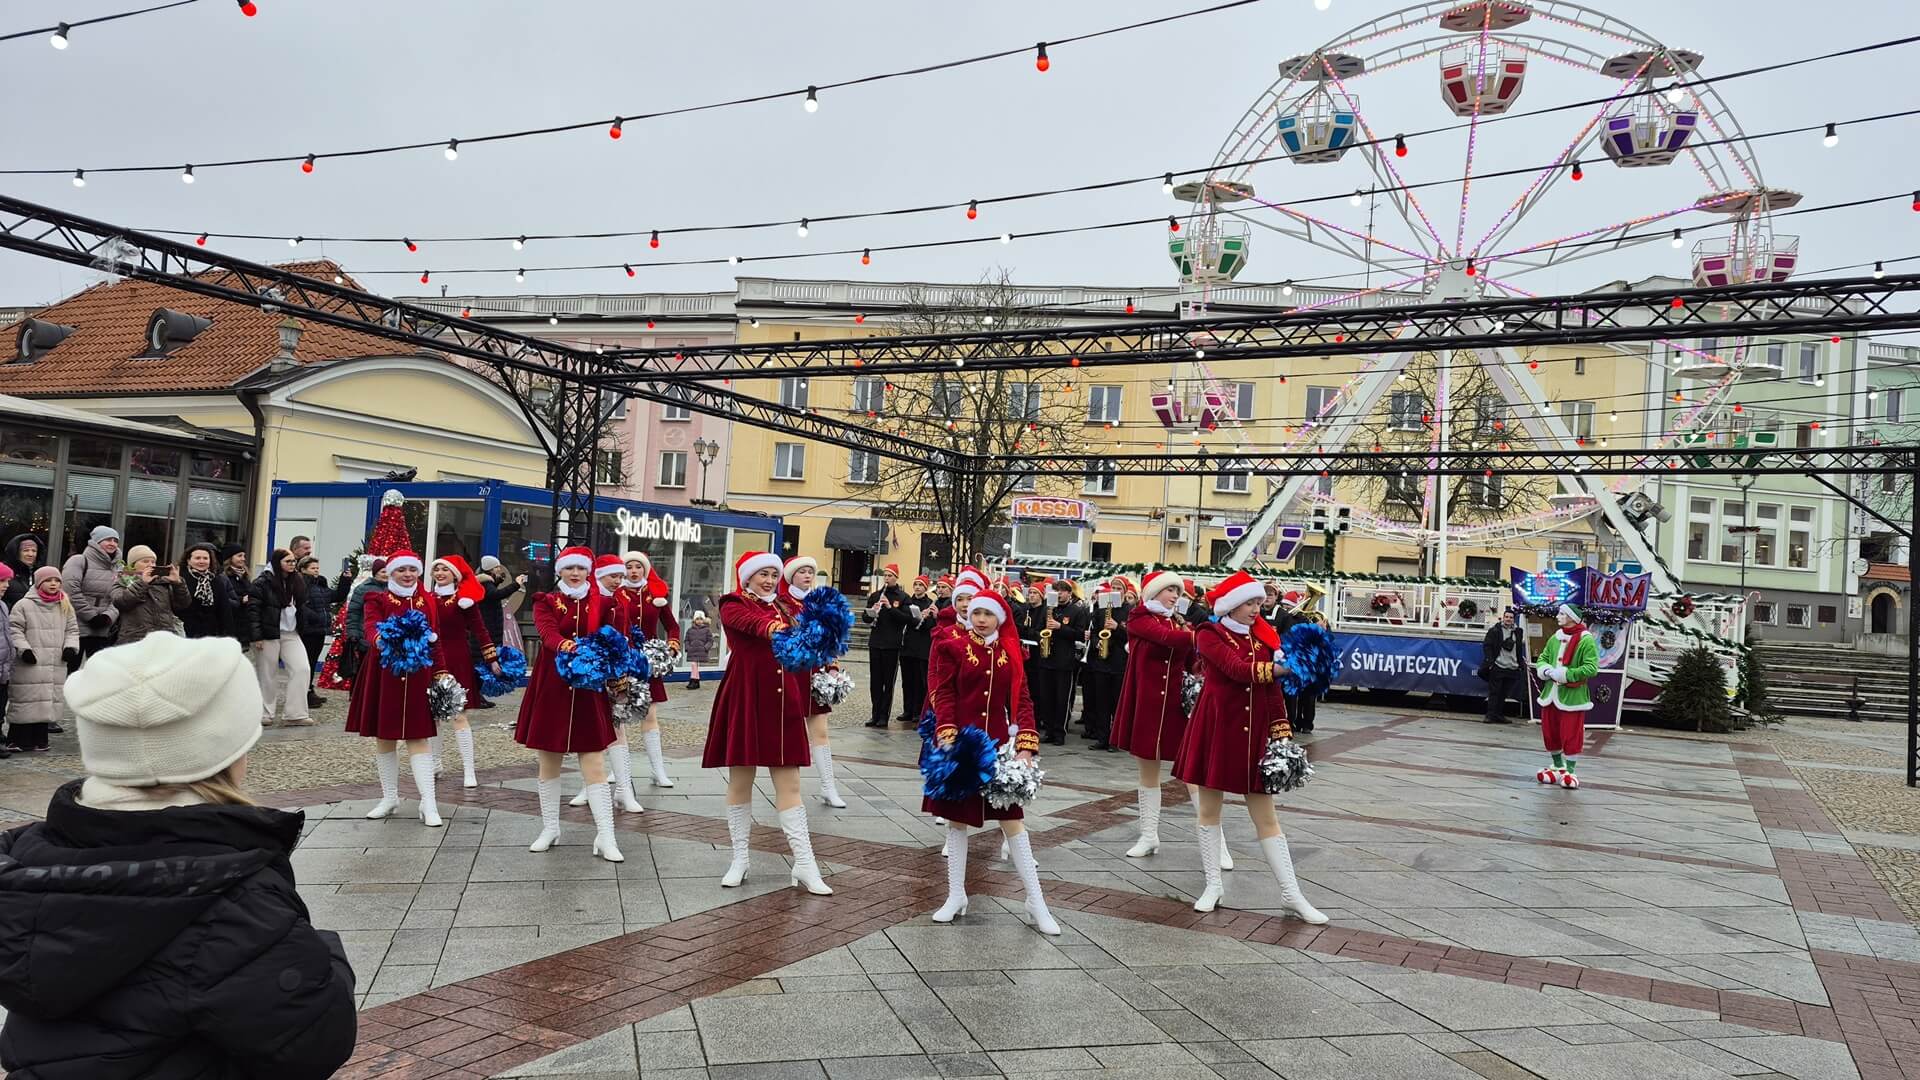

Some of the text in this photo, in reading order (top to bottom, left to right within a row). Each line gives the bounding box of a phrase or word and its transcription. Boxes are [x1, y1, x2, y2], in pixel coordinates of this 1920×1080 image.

[478, 486, 491, 496] 267
[1016, 501, 1080, 518] KASSA
[1589, 573, 1646, 607] KASSA
